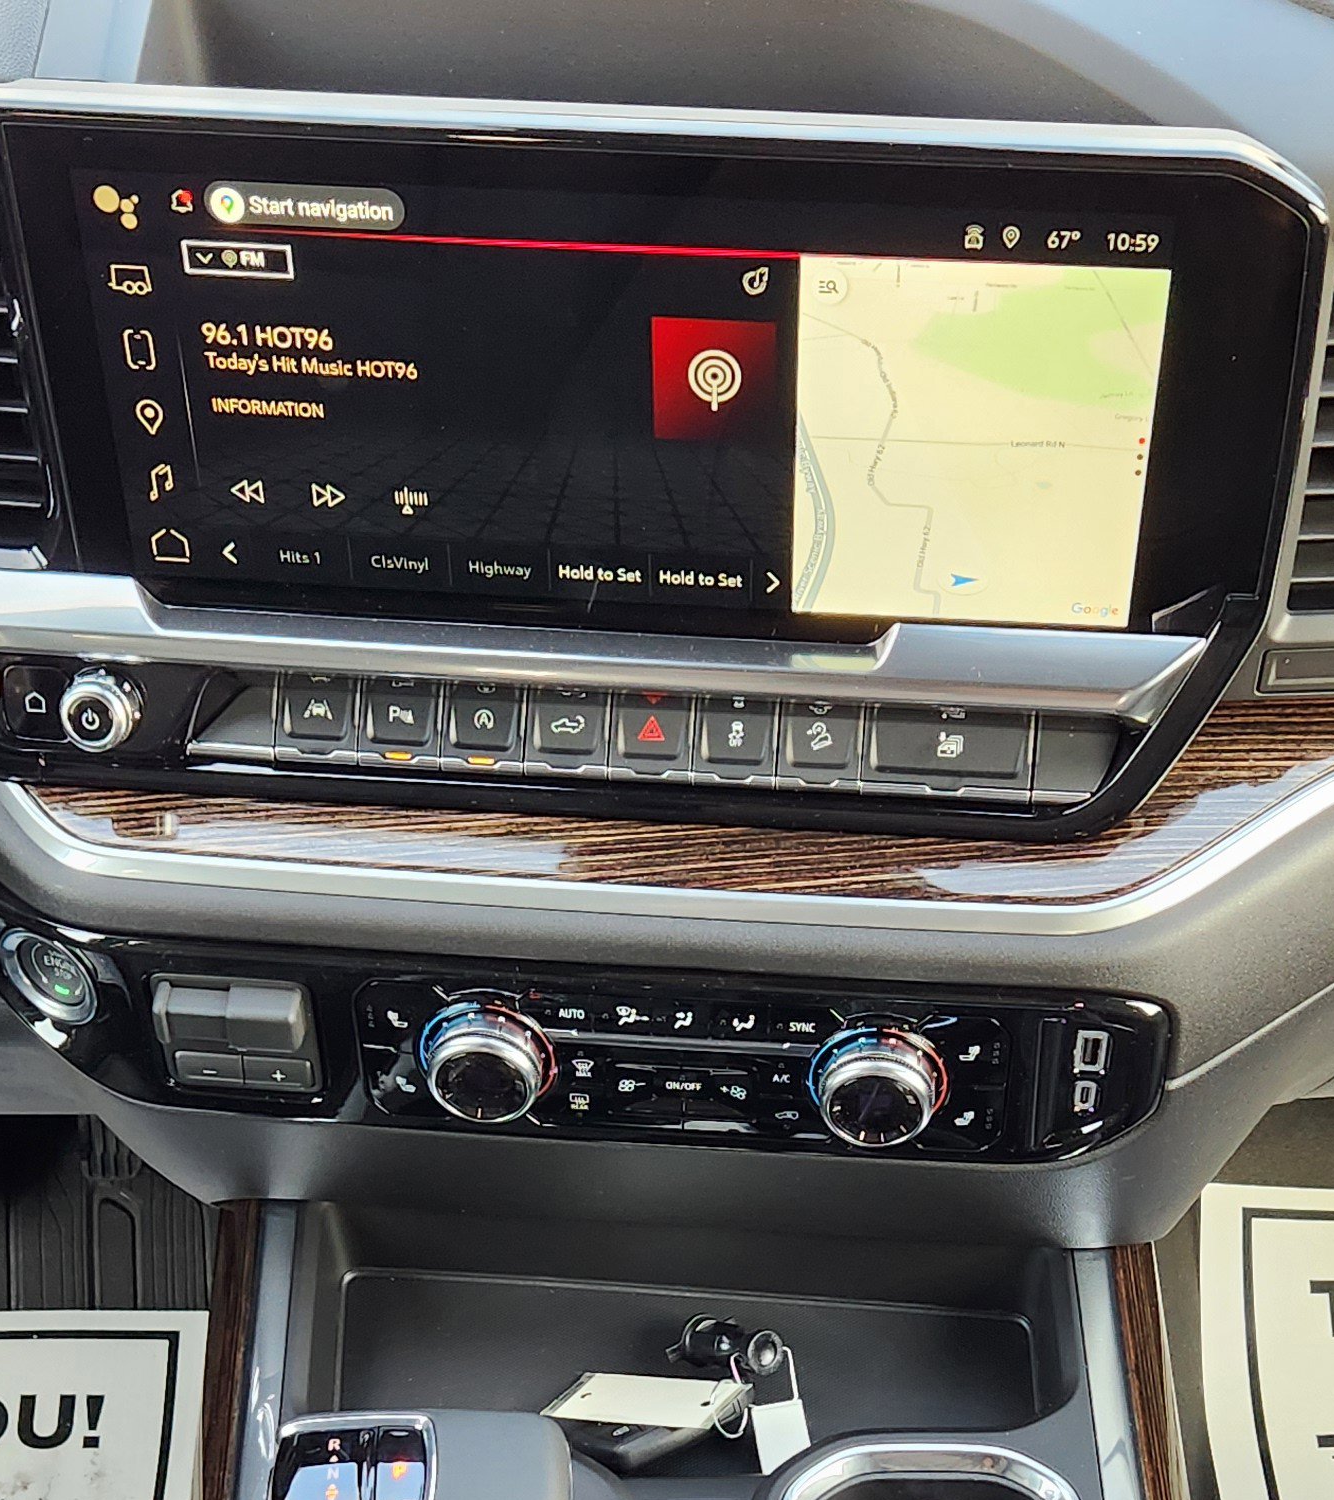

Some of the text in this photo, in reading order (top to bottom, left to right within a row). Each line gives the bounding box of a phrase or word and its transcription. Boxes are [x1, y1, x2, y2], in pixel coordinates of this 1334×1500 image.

[248, 195, 395, 223] Start navigation
[1107, 232, 1161, 253] 10:59
[239, 250, 266, 268] FM
[200, 321, 334, 351] 96.1 HOT96
[203, 351, 418, 380] Today's Hit Music HOT96
[211, 397, 325, 419] INFORMATION
[1010, 440, 1044, 448] Leonard
[279, 550, 310, 564] Hits
[370, 555, 430, 574] ClsVinyl
[468, 560, 532, 580] Highway
[558, 564, 642, 583] Hold to Set
[659, 569, 743, 588] Hold to Set
[1071, 602, 1119, 618] Google
[558, 1007, 585, 1020] AUTO
[788, 1021, 816, 1034] SYNC
[665, 1080, 703, 1092] ON/OFF
[772, 1074, 791, 1084] A/C
[327, 1438, 341, 1451] R
[326, 1467, 340, 1480] N
[392, 1462, 408, 1481] P
